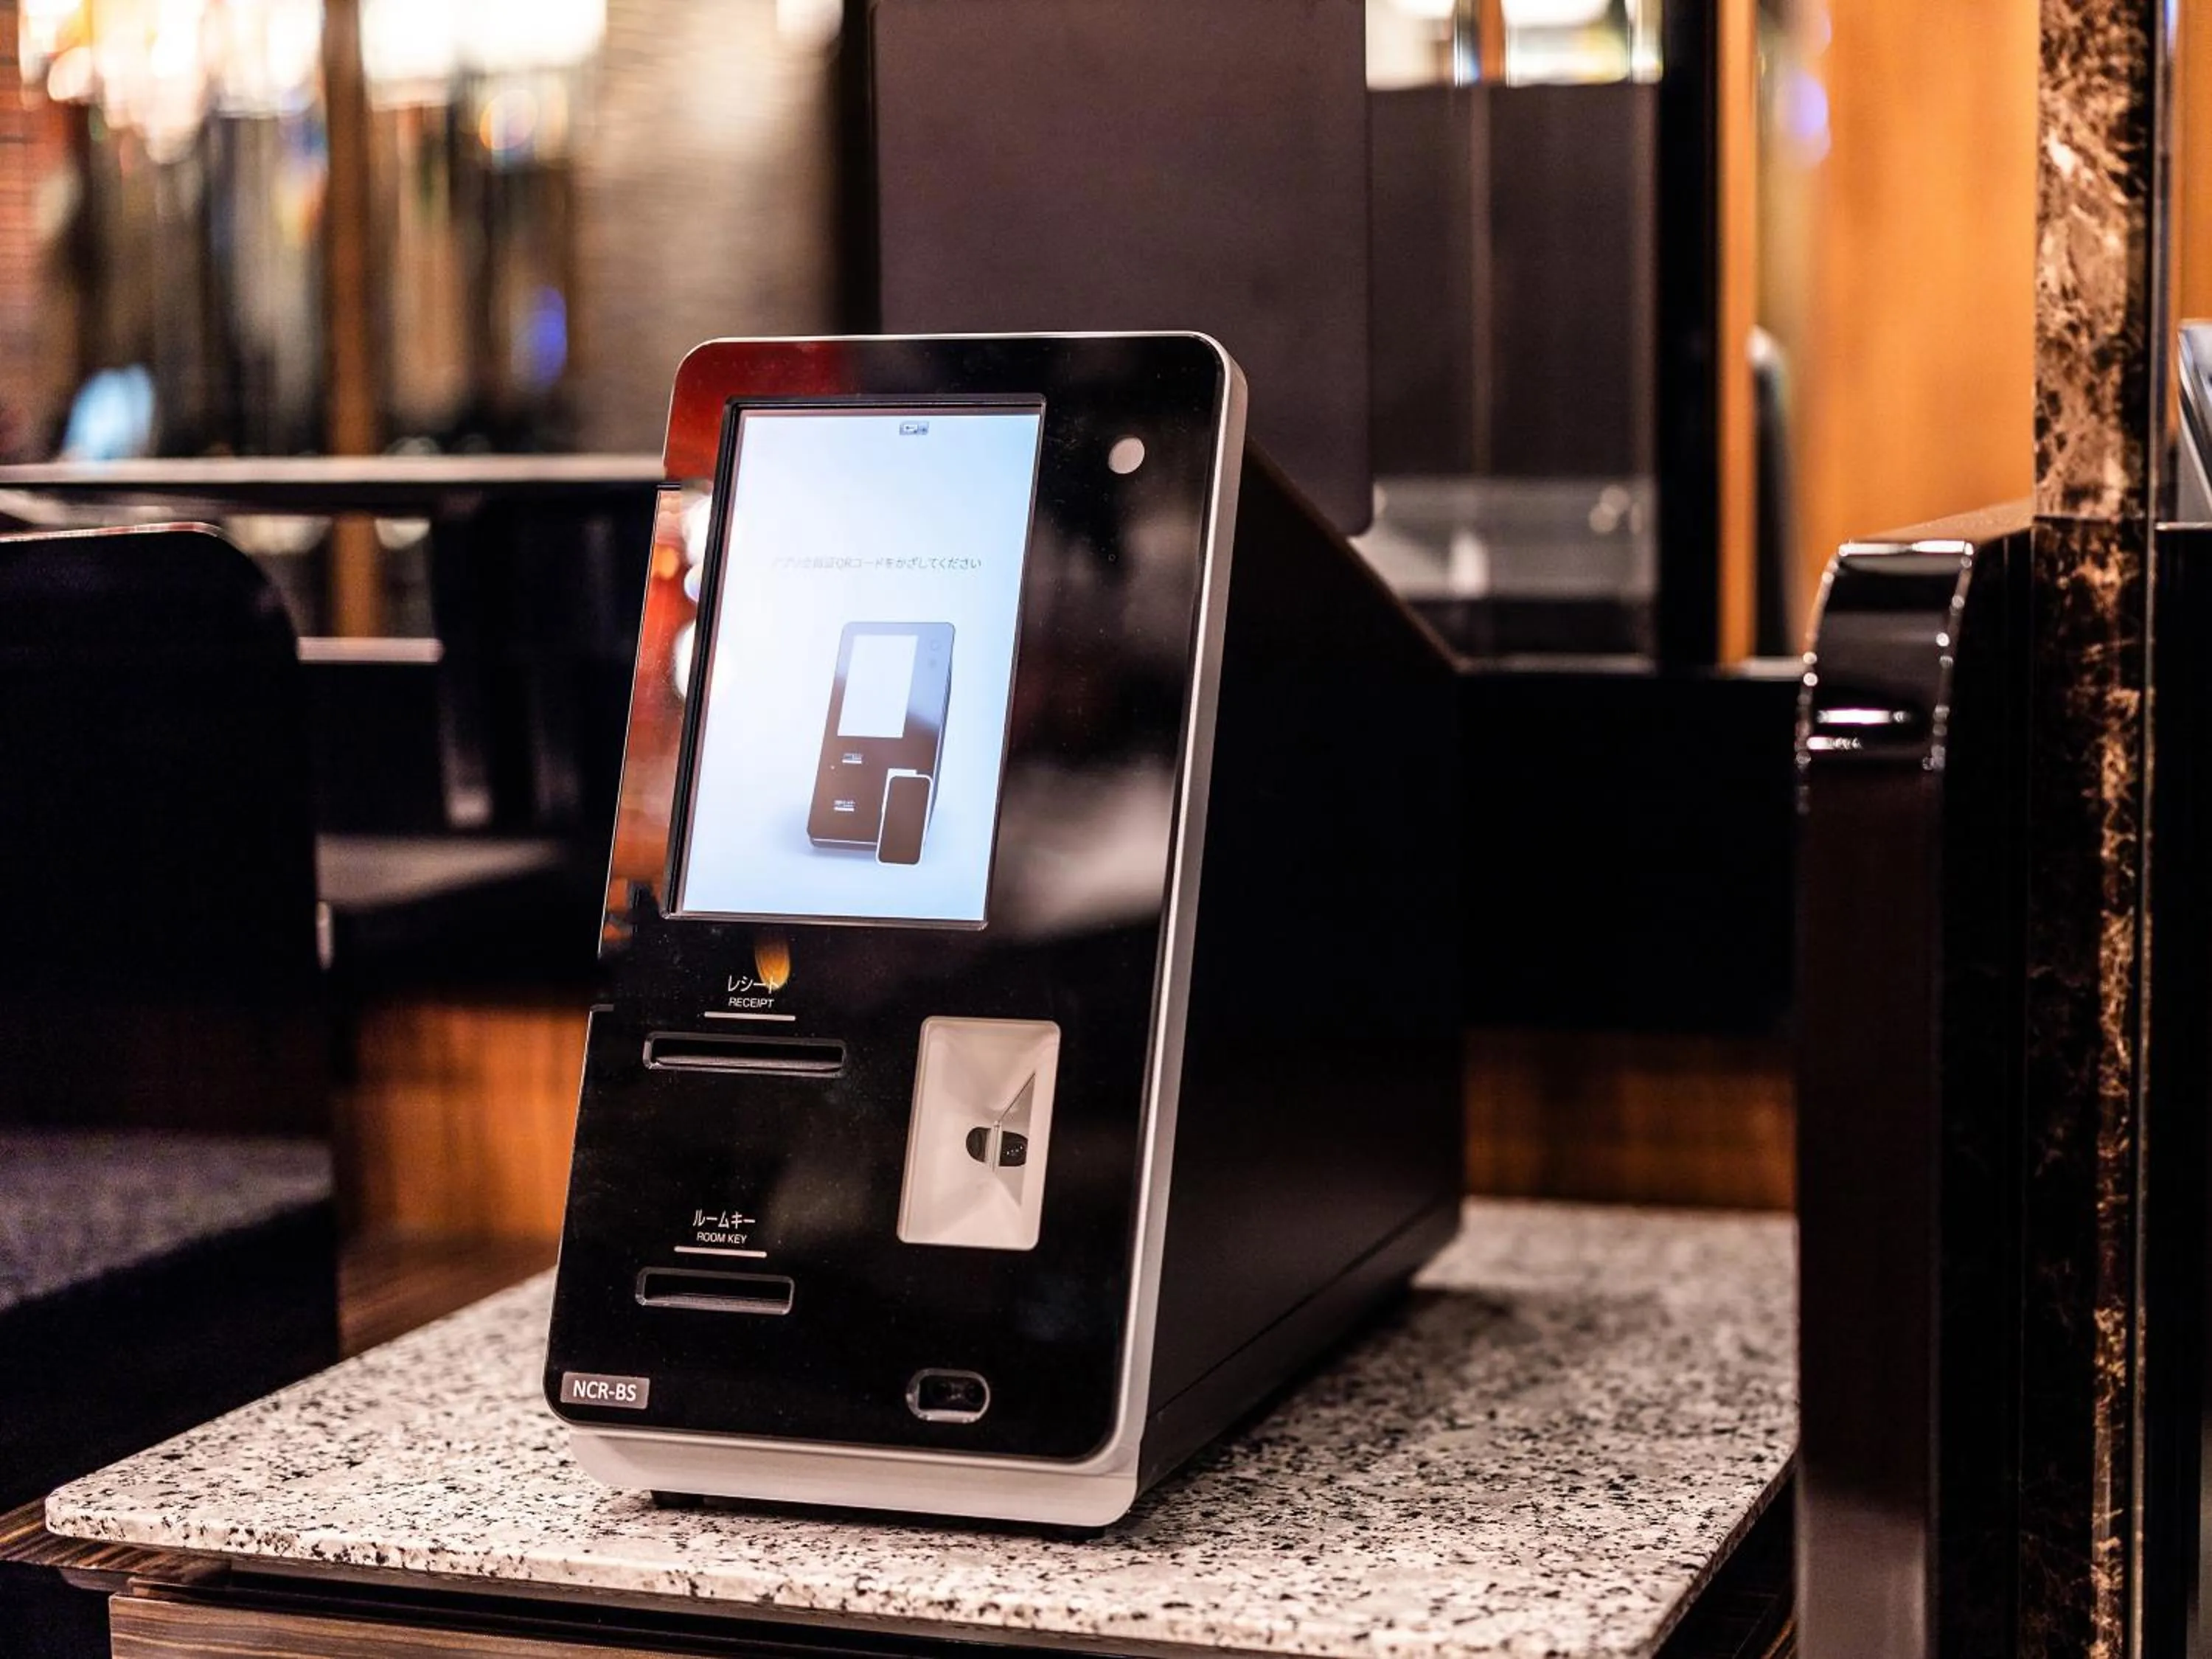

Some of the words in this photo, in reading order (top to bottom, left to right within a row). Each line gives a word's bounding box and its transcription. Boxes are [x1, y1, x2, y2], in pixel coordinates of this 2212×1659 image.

[727, 975, 779, 995] レシート
[728, 996, 775, 1009] RECEIPT
[692, 1208, 756, 1229] ルームキー
[696, 1231, 726, 1243] ROOM
[727, 1234, 748, 1245] KEY
[572, 1379, 638, 1402] NCR-BS
